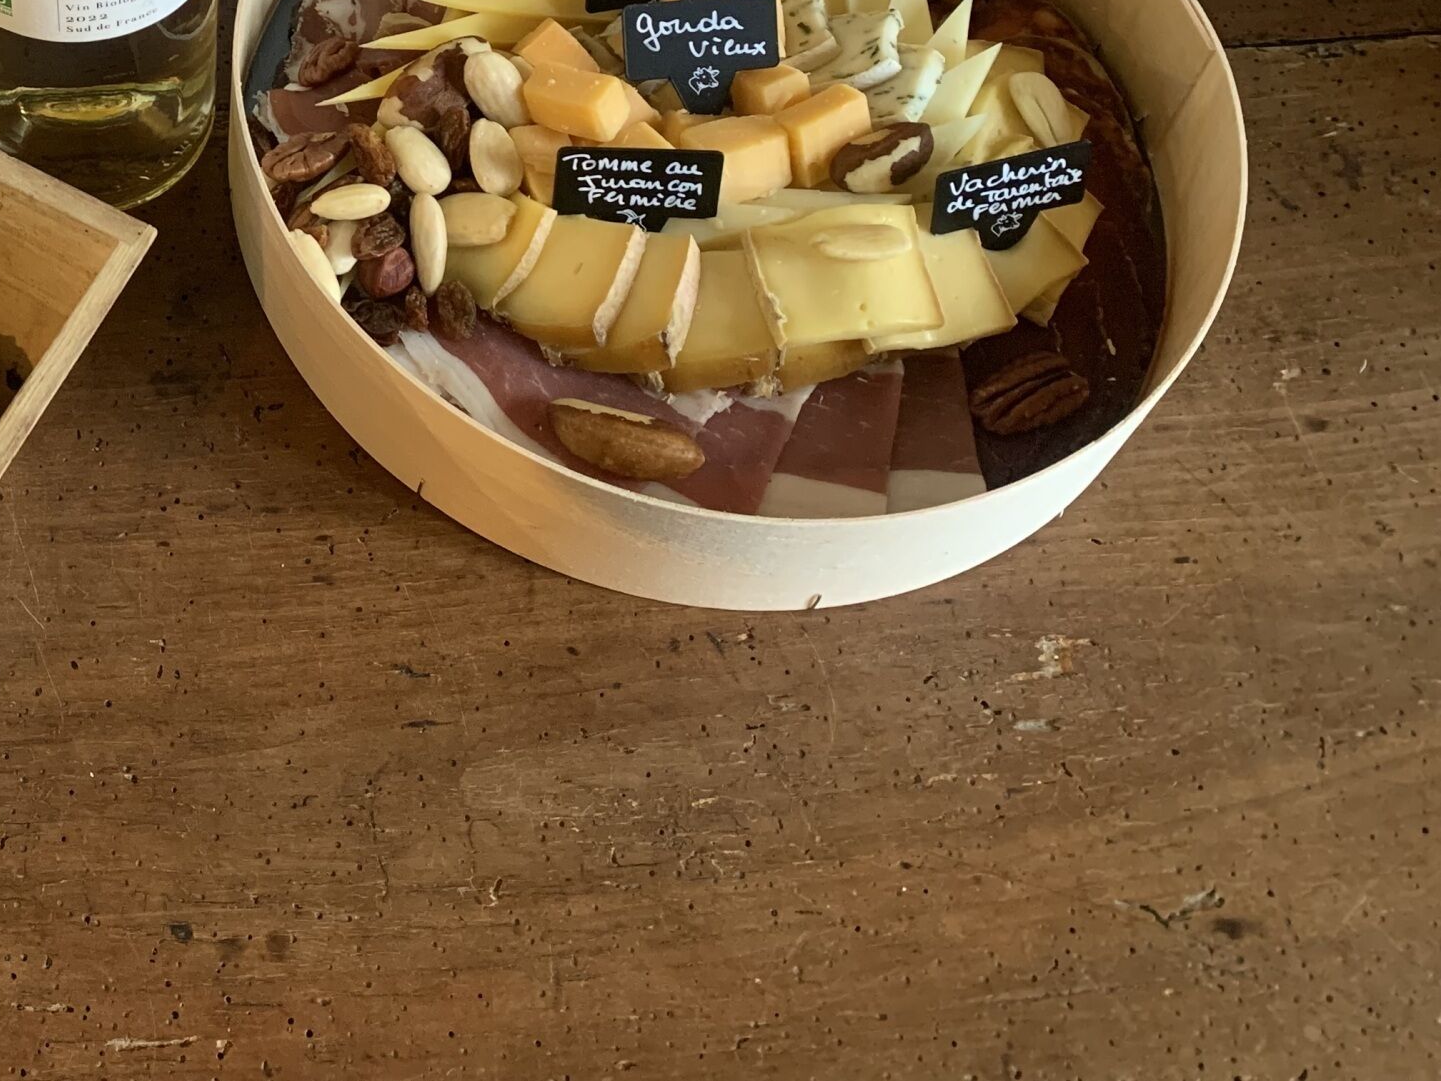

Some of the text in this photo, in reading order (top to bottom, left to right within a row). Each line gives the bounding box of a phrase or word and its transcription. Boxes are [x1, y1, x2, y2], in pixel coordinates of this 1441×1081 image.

[65, 4, 90, 12] Vin
[66, 13, 108, 23] 2022
[66, 7, 158, 33] Sud de France
[562, 153, 703, 176] Tomme au
[950, 156, 1066, 196] Vacherin
[947, 196, 975, 213] de
